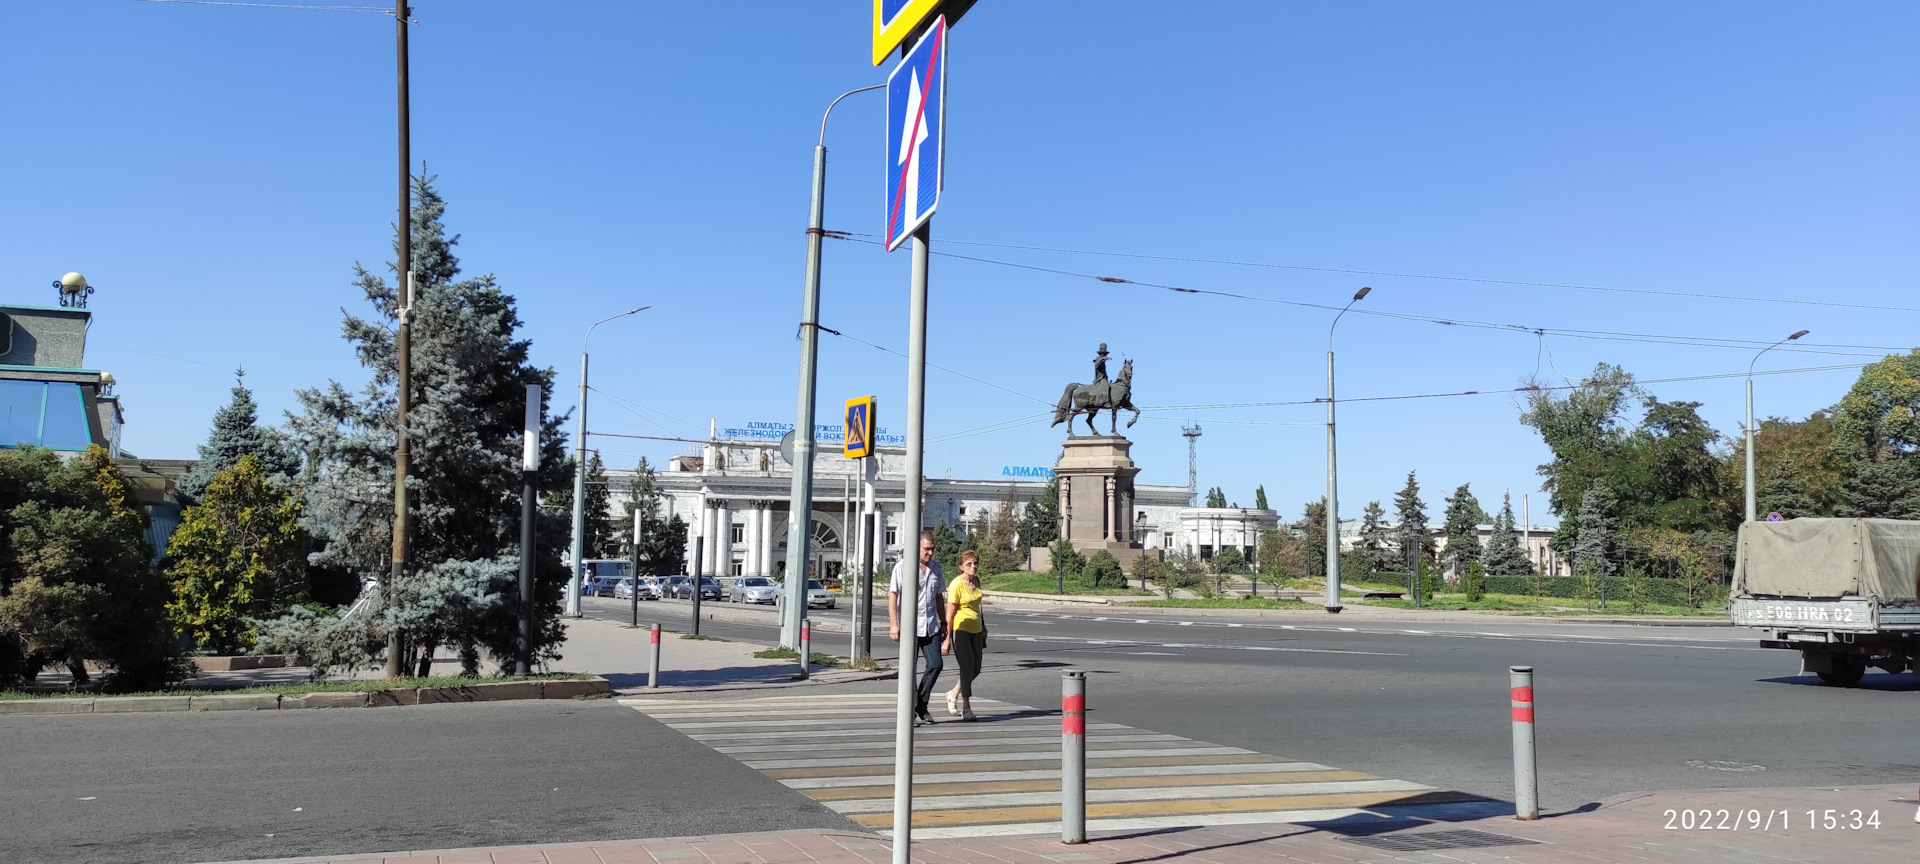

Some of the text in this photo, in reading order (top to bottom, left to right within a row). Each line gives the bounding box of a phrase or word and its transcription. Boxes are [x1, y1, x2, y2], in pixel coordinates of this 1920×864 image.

[746, 421, 787, 430] АЛМАТЫ
[1766, 605, 1793, 620] 506
[1797, 605, 1830, 620] HRA
[1834, 607, 1853, 622] 02
